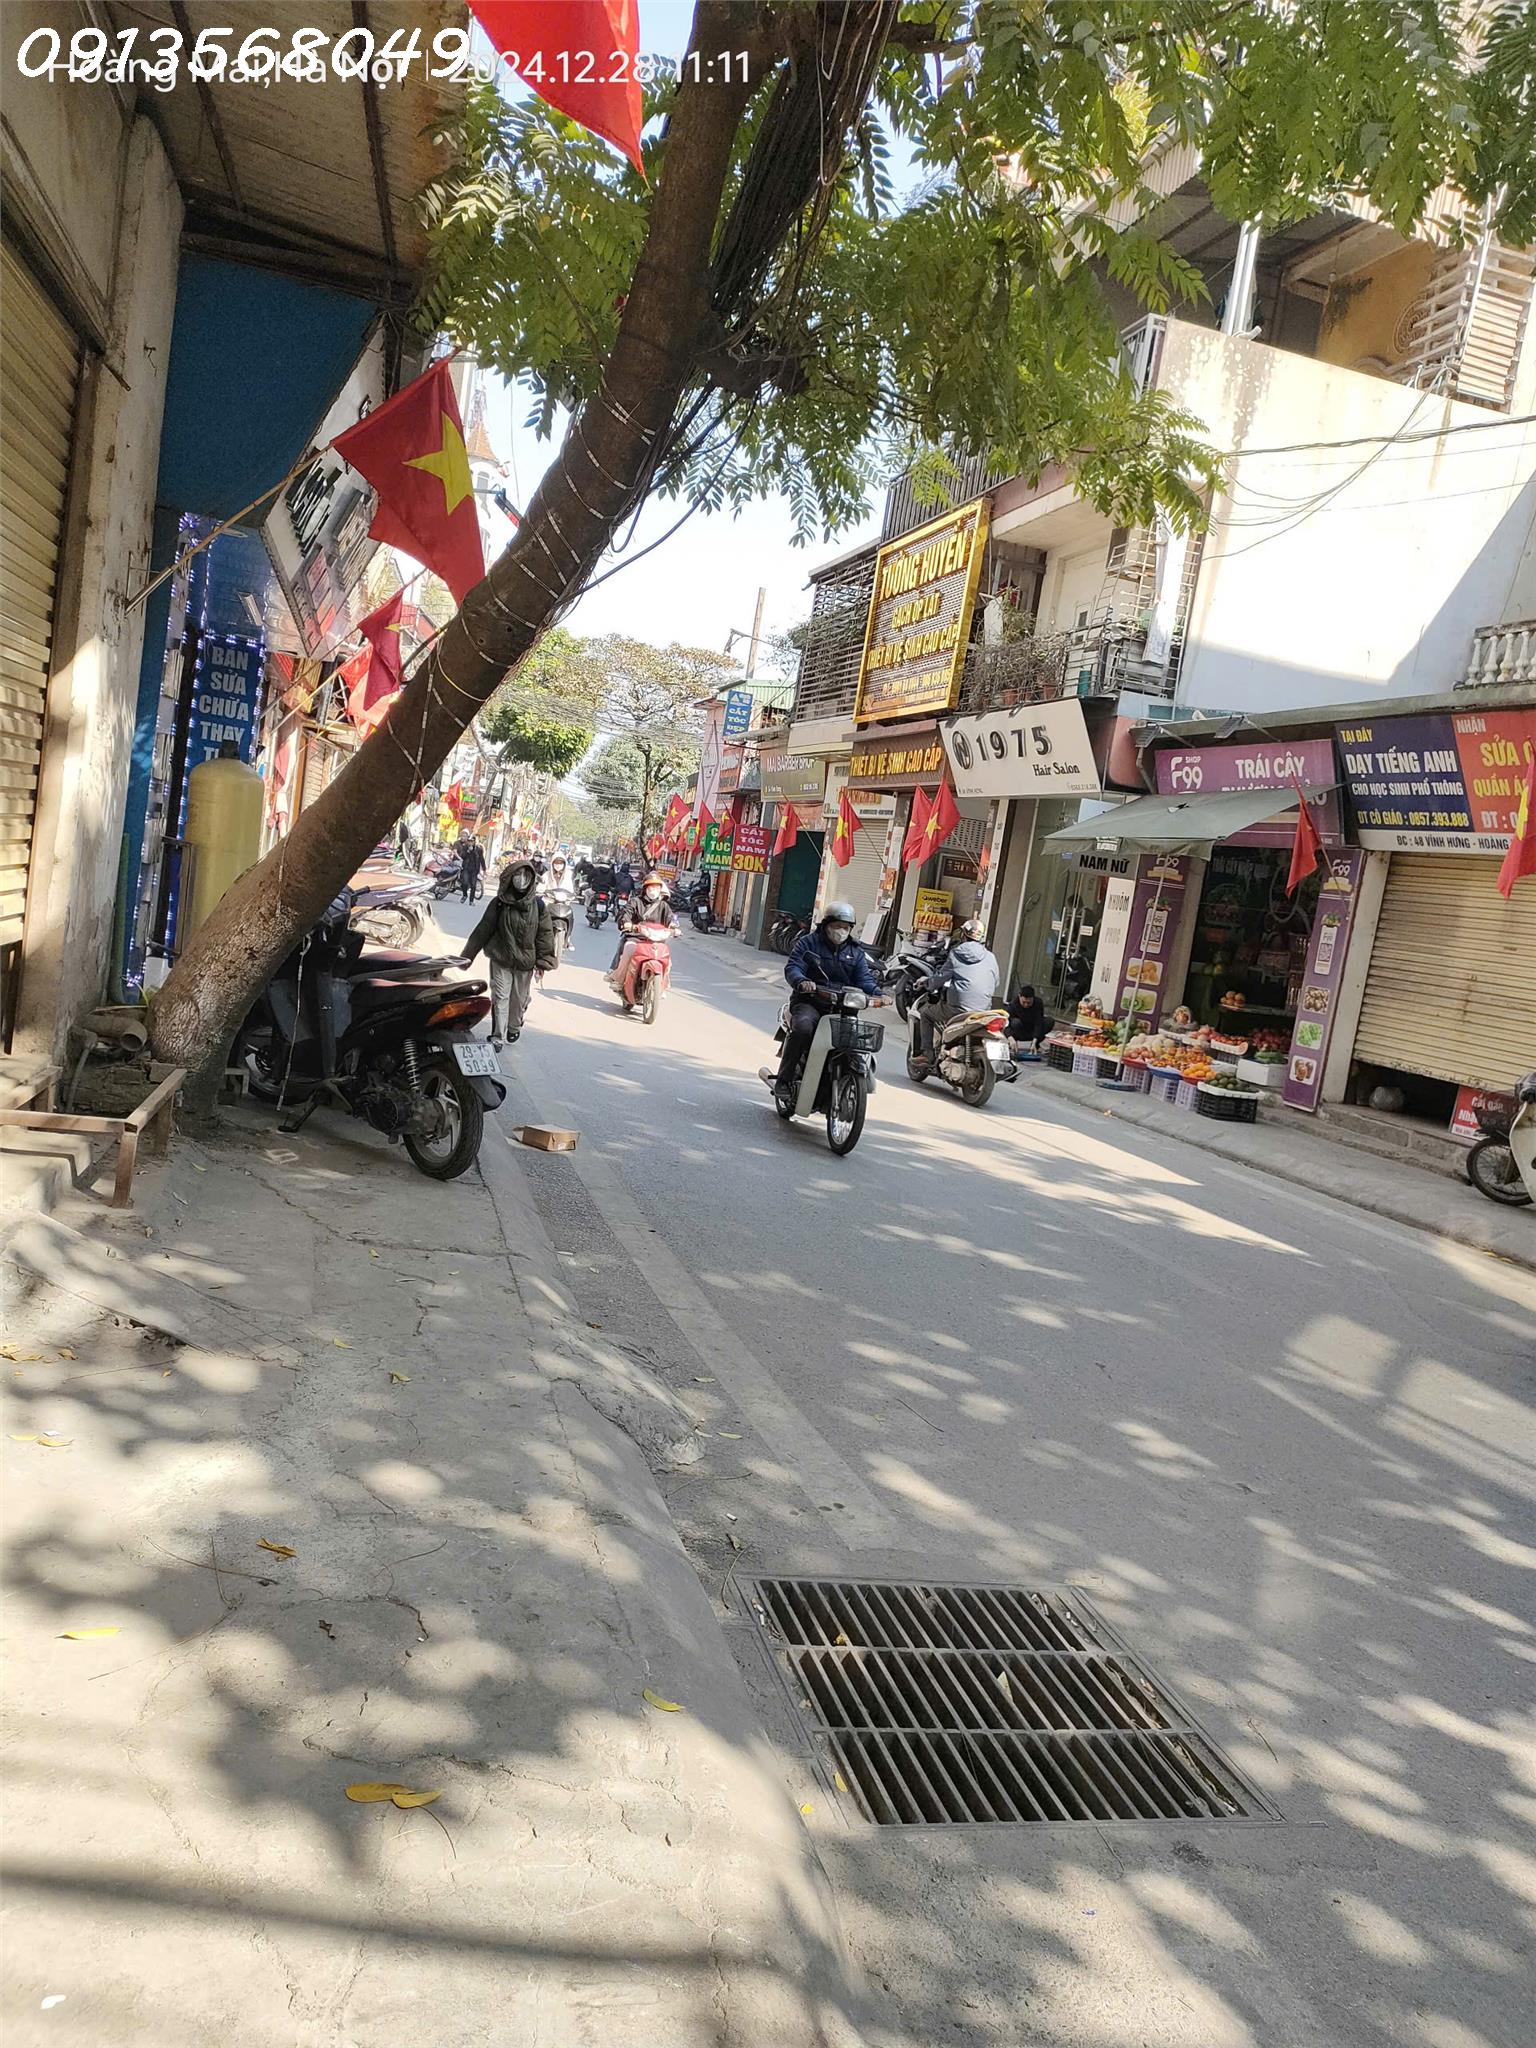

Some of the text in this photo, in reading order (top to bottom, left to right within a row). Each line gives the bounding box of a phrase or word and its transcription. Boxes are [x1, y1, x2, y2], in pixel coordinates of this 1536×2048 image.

[210, 669, 247, 696] SỬA
[199, 694, 249, 722] CHỮA
[200, 720, 246, 746] THAY
[1340, 726, 1373, 746] TẠI ĐÂY
[1456, 717, 1487, 736] NHẬN
[975, 724, 1053, 762] 1975
[1479, 733, 1521, 767] SỬA
[887, 751, 907, 775] SINH
[905, 748, 924, 773] CAO
[923, 736, 943, 772] CẤP
[1185, 756, 1202, 764] SHOP
[1234, 750, 1306, 779] TRÁI CÂY
[1345, 746, 1458, 778] DẠY TIẾNG ANH
[1032, 762, 1081, 777] Hair Salon
[1352, 783, 1369, 796] CHO
[1369, 782, 1387, 798] HỌC
[1389, 783, 1411, 796] SINH
[1432, 779, 1464, 796] THÔNG
[1473, 773, 1511, 798] QUẦN
[1369, 808, 1382, 825] CÔ
[1382, 808, 1403, 825] GIÁO
[736, 844, 767, 855] NAM
[1414, 835, 1425, 846] 48
[1446, 835, 1471, 849] HƯNG
[1478, 834, 1510, 851] HOÀNG
[733, 853, 766, 873] 30K
[1079, 854, 1130, 875] NAM NỮ
